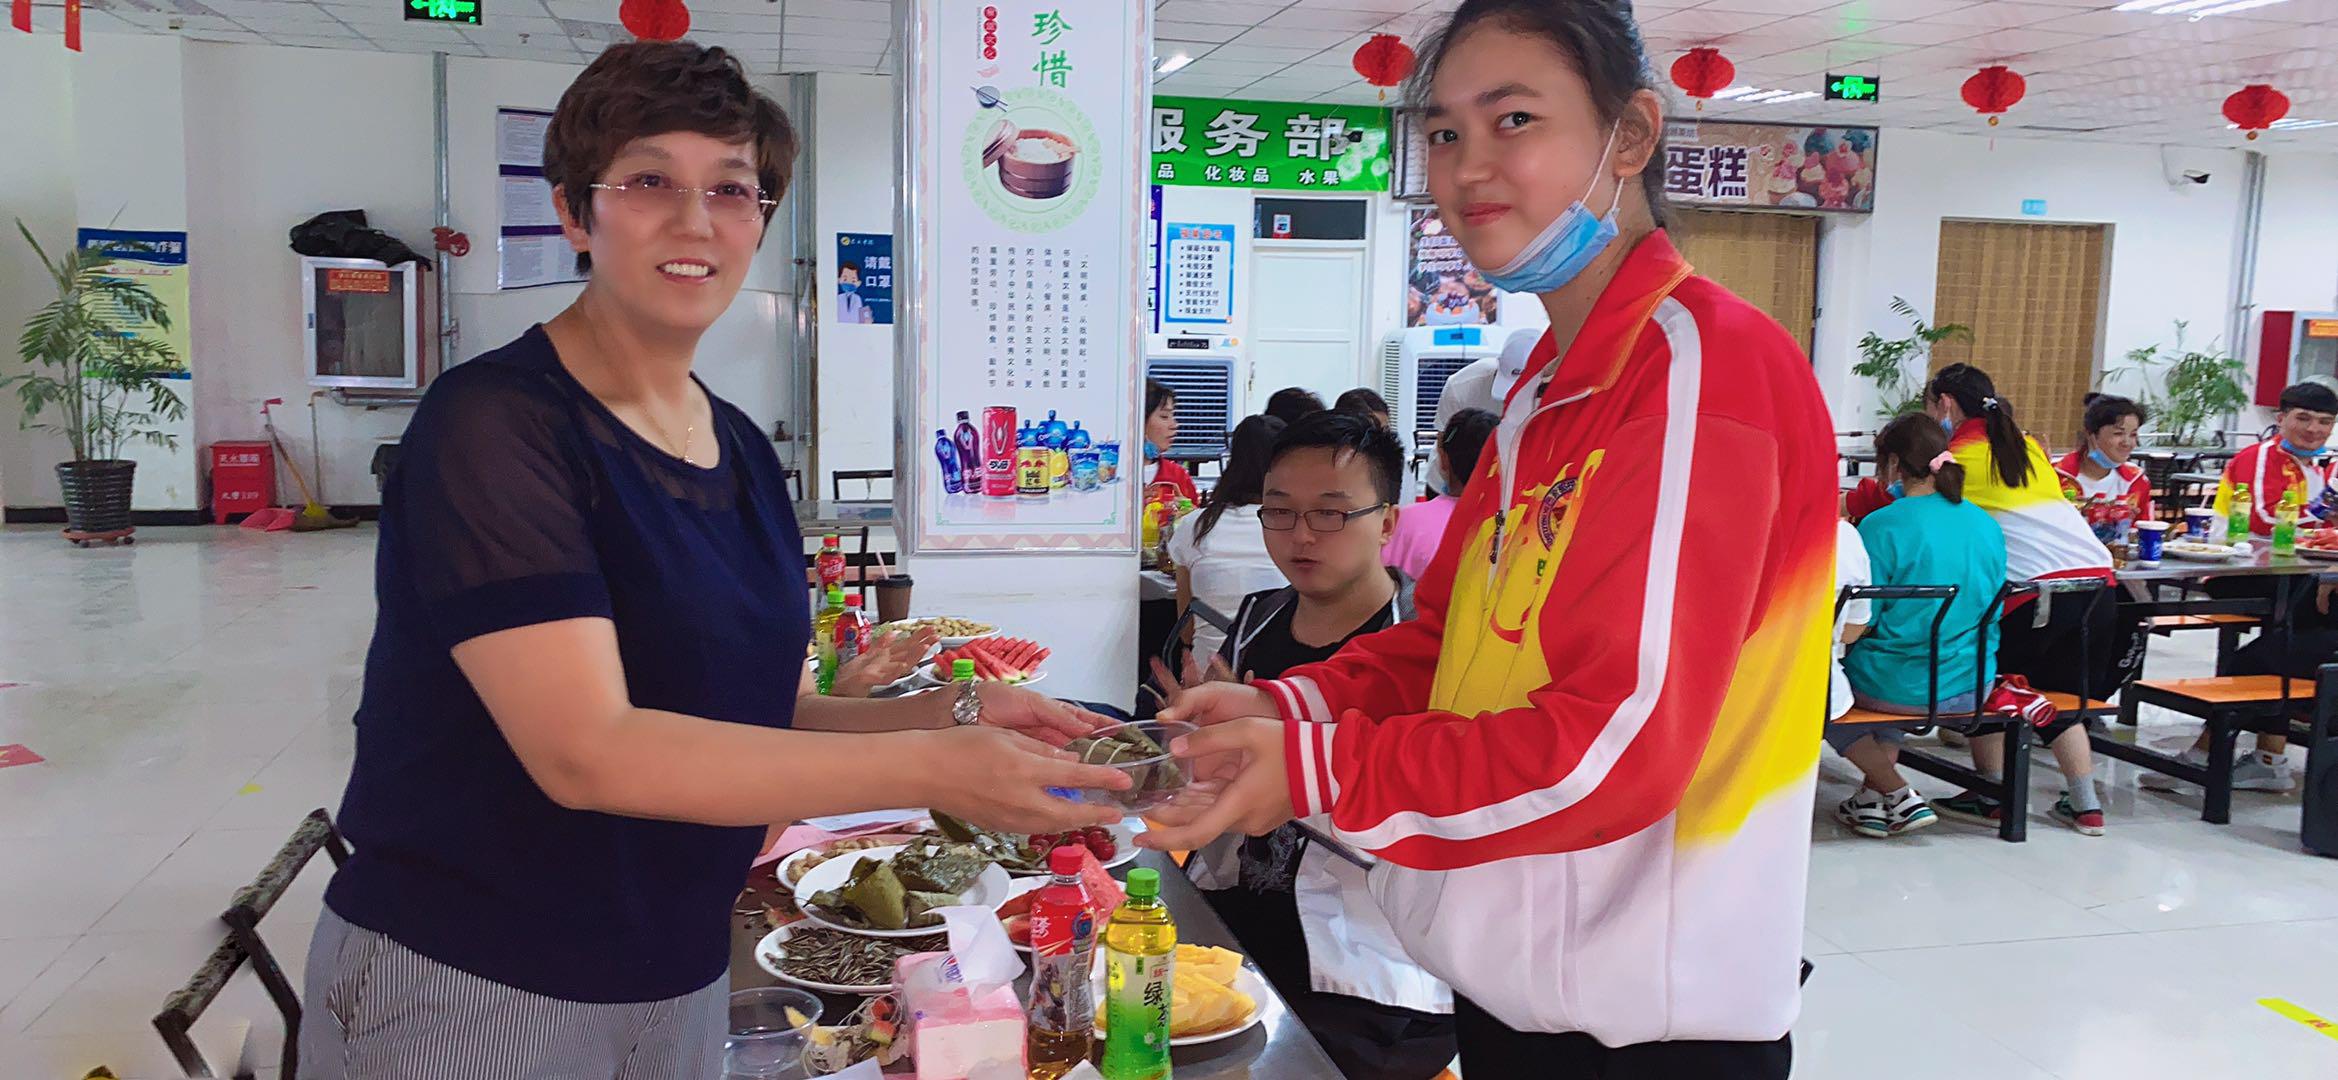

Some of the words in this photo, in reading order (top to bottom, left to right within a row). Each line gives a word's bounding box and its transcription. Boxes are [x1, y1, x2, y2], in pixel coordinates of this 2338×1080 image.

[1031, 8, 1073, 89] 珍惜
[1205, 165, 1270, 183] 化妆品
[1299, 168, 1341, 186] 水果
[1665, 146, 1747, 197] 蛋糕
[864, 255, 892, 270] 请戴
[865, 274, 892, 288] 口罩
